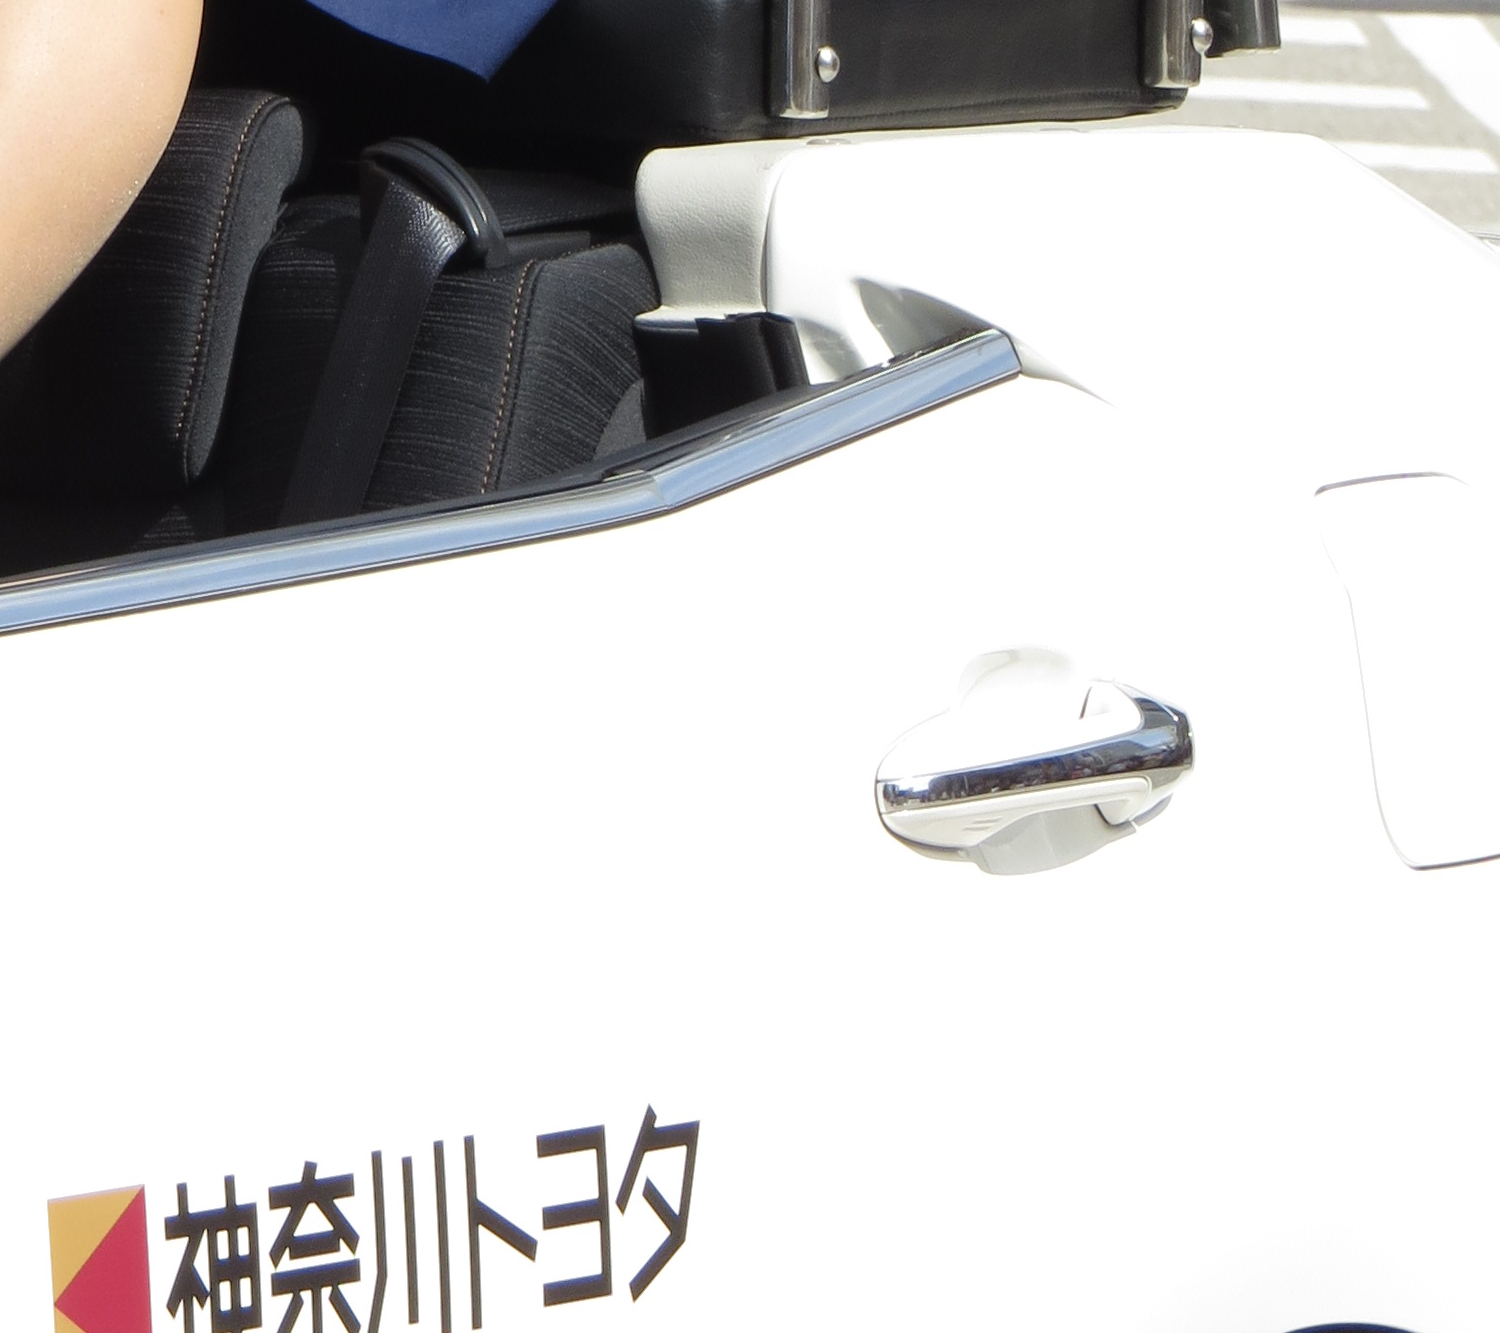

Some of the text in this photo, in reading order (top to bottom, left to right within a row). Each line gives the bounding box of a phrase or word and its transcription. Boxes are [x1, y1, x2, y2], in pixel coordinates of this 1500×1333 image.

[164, 1103, 701, 1333] 神奈川トヨタ
